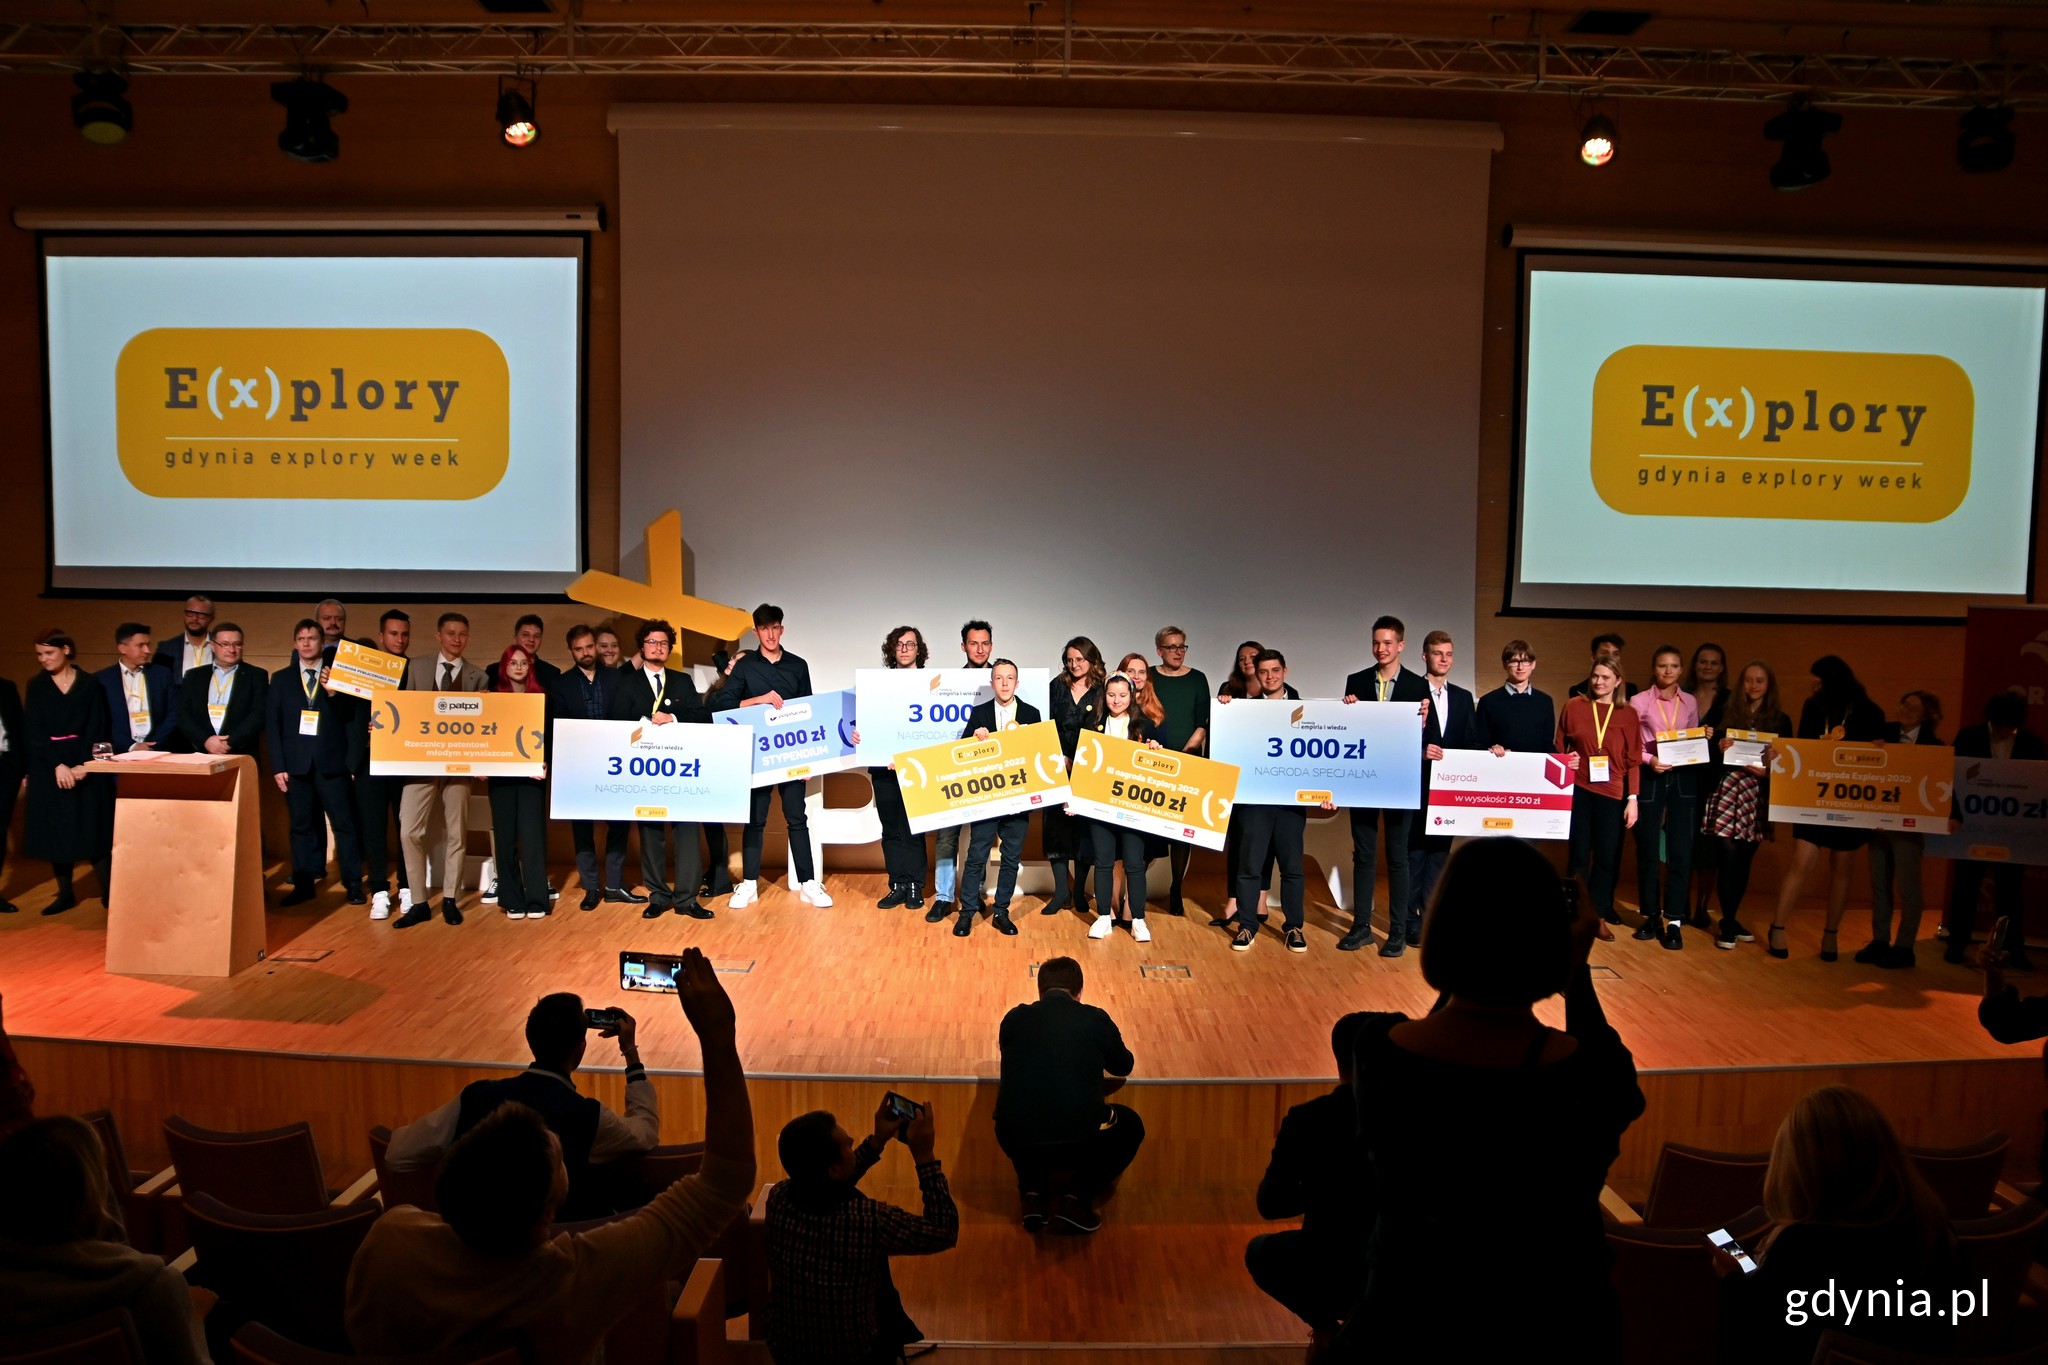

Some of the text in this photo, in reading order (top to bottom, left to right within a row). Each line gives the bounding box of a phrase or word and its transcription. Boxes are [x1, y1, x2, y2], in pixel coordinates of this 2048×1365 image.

[165, 366, 459, 422] E(x)plory
[1642, 385, 1927, 446] E(x)plory
[165, 449, 459, 468] gdynia explory week
[1639, 466, 1922, 490] gdynia explory week
[449, 702, 479, 710] patpol
[909, 704, 974, 723] 3 000
[420, 722, 498, 735] 3 000 zł
[759, 726, 826, 751] 3 000 zł
[898, 732, 948, 740] NAGRODA
[405, 741, 489, 750] Rzecznicy patentowi
[427, 750, 514, 758] młodym wynalazcom
[762, 745, 829, 766] STYPENDIUM
[1268, 737, 1367, 759] 3 000 zł
[608, 757, 701, 777] 3 000 zł
[941, 769, 973, 782] nagroda
[973, 763, 1004, 776] Explory
[1005, 757, 1026, 768] 2022
[1255, 767, 1310, 777] NAGRODA
[1815, 771, 1850, 781] nagroda
[1852, 773, 1885, 783] Explory
[1887, 775, 1912, 783] 2022
[941, 769, 1027, 800] 10 000 zł
[1115, 770, 1146, 783] nagroda
[1147, 777, 1177, 791] Explory
[1178, 784, 1200, 796] 2022
[1437, 773, 1478, 783] Nagroda
[595, 784, 648, 794] NAGRODA
[951, 787, 1026, 808] STYPENDIUM NAUKOWE
[1112, 781, 1187, 813] 5 000 zł
[1817, 783, 1902, 803] 7 000 zł
[1109, 797, 1151, 813] STYPENDIUM
[1152, 807, 1185, 820] NAUKOWE
[1465, 795, 1507, 804] wysokości
[1509, 796, 1515, 804] 2
[1516, 797, 1532, 805] 500
[1533, 797, 1541, 805] zł
[1816, 801, 1863, 810] STYPENDIUM
[1965, 795, 2048, 819] 000 zł
